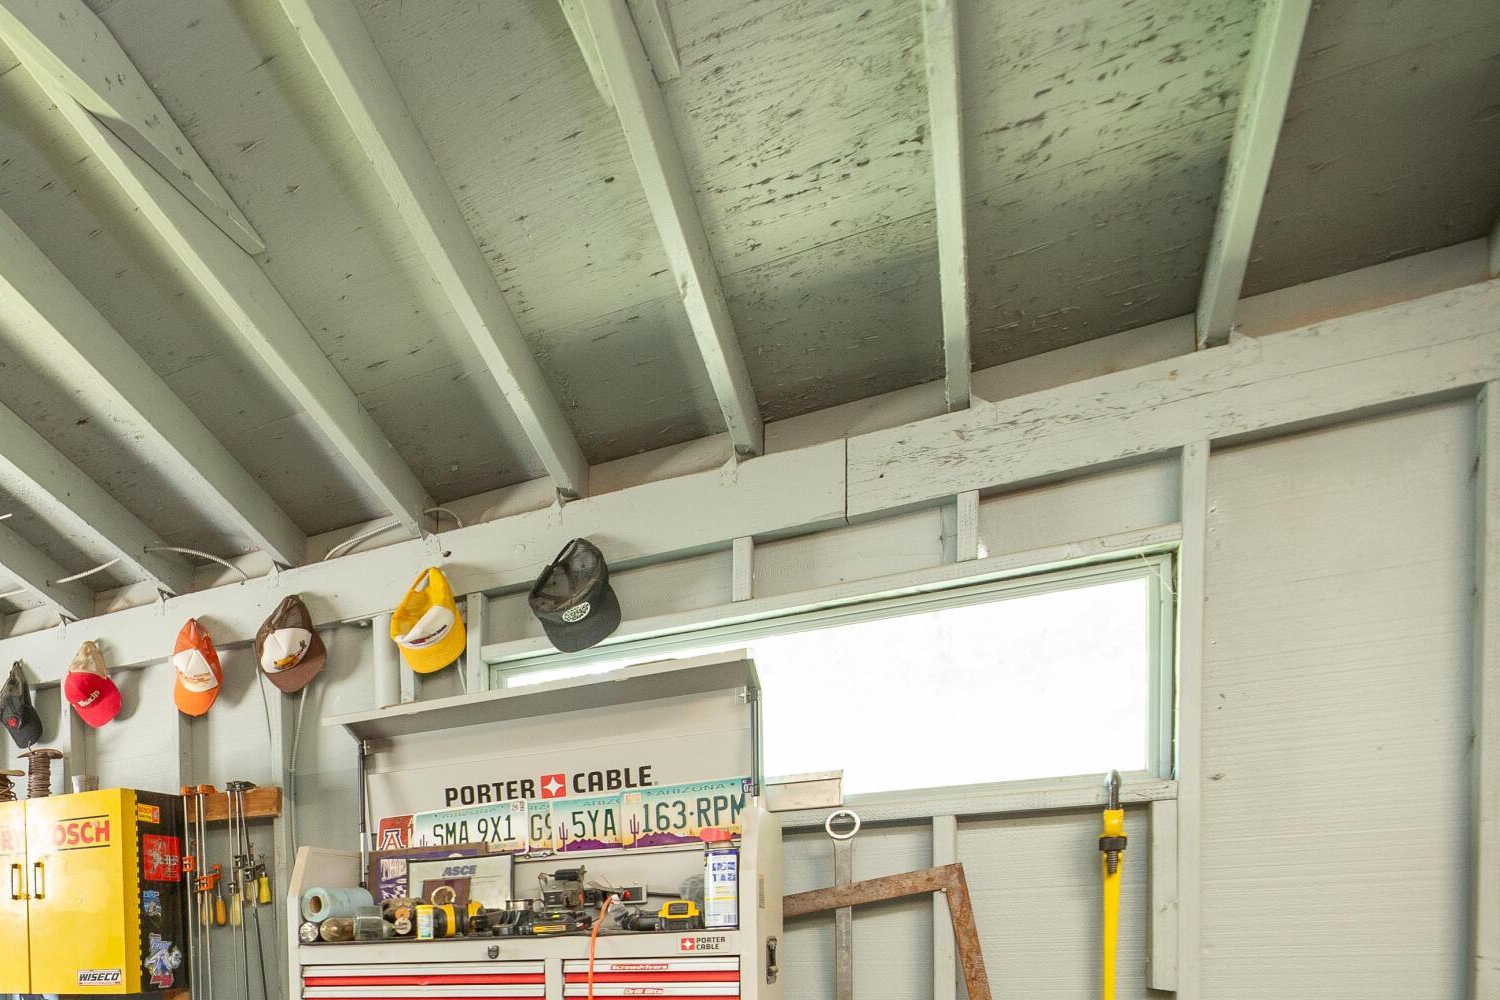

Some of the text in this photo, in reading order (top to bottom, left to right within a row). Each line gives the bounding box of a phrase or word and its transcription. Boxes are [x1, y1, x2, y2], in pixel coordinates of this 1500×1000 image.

[445, 766, 652, 807] PORTER CABLE
[655, 781, 725, 796] ARIZONA
[52, 819, 111, 848] OSCH
[433, 814, 516, 847] SMA 9X1
[442, 864, 477, 877] ASCE
[696, 936, 726, 944] PORTER
[79, 972, 119, 981] WISECO
